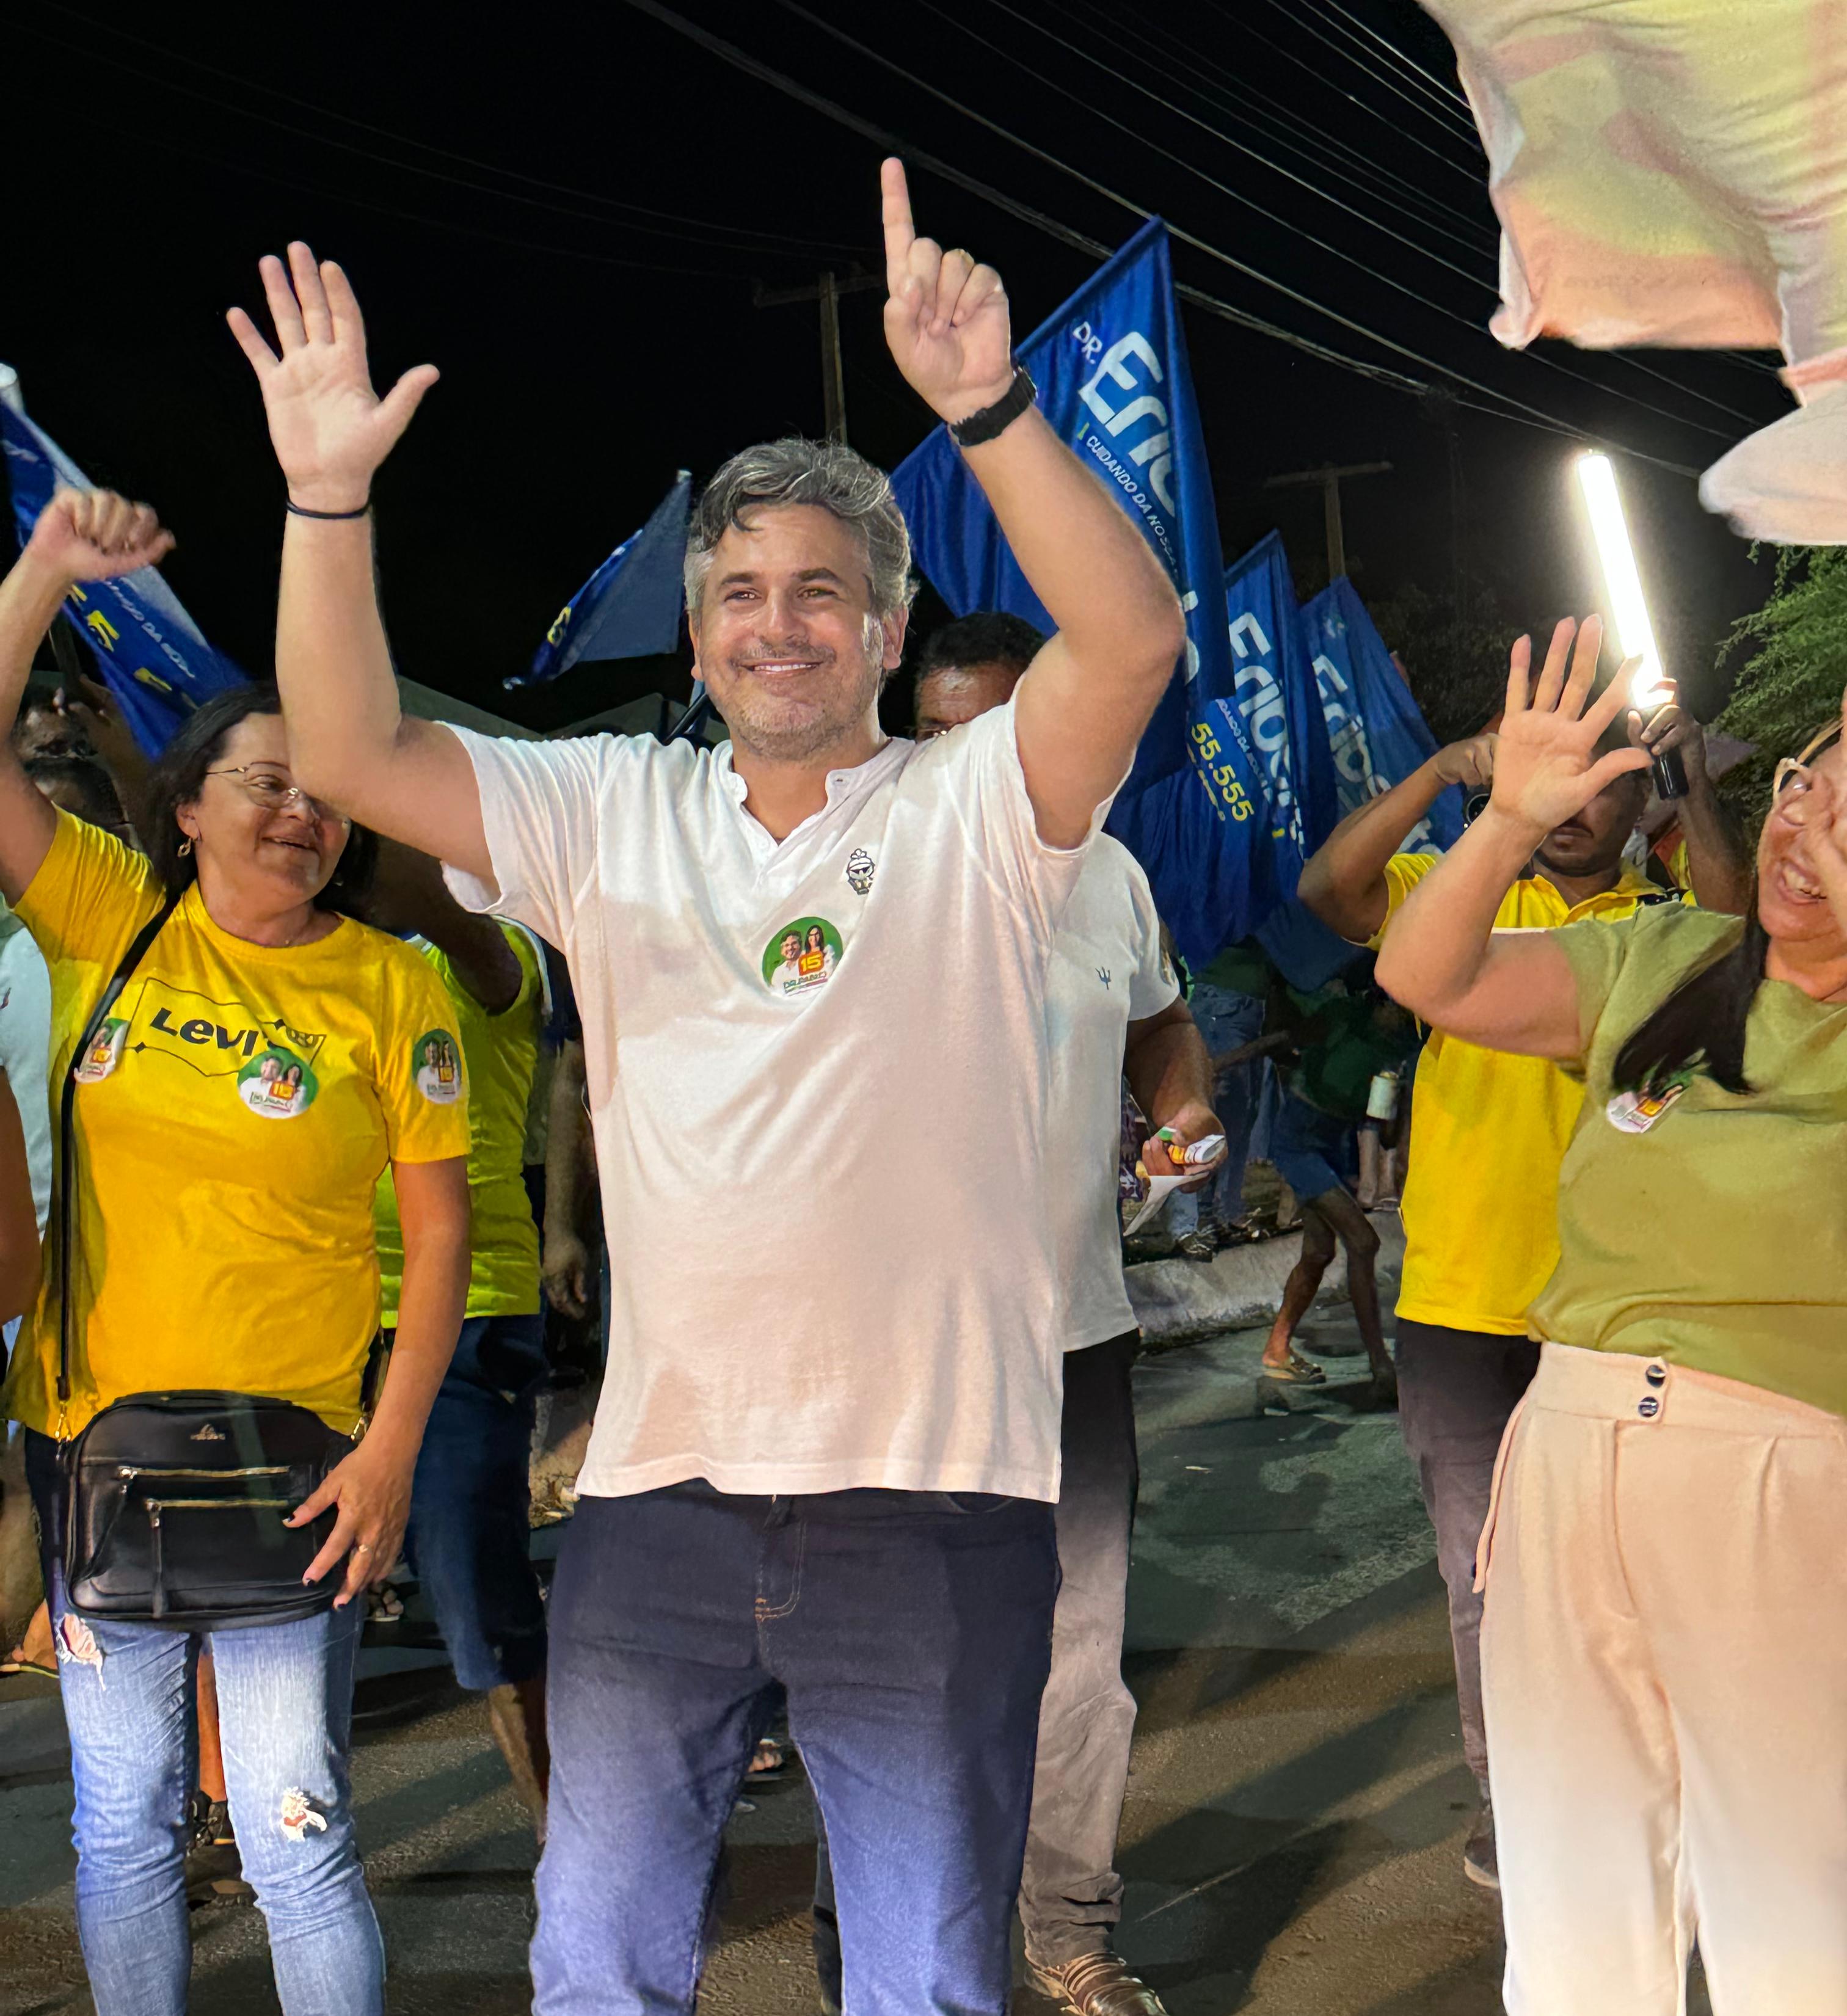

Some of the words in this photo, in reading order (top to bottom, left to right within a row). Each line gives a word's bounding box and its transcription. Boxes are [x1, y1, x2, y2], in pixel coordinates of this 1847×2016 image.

[1073, 321, 1103, 365] DR.
[1132, 493, 1152, 514] DA
[1192, 723, 1255, 821] 55.555
[801, 953, 822, 972] 15
